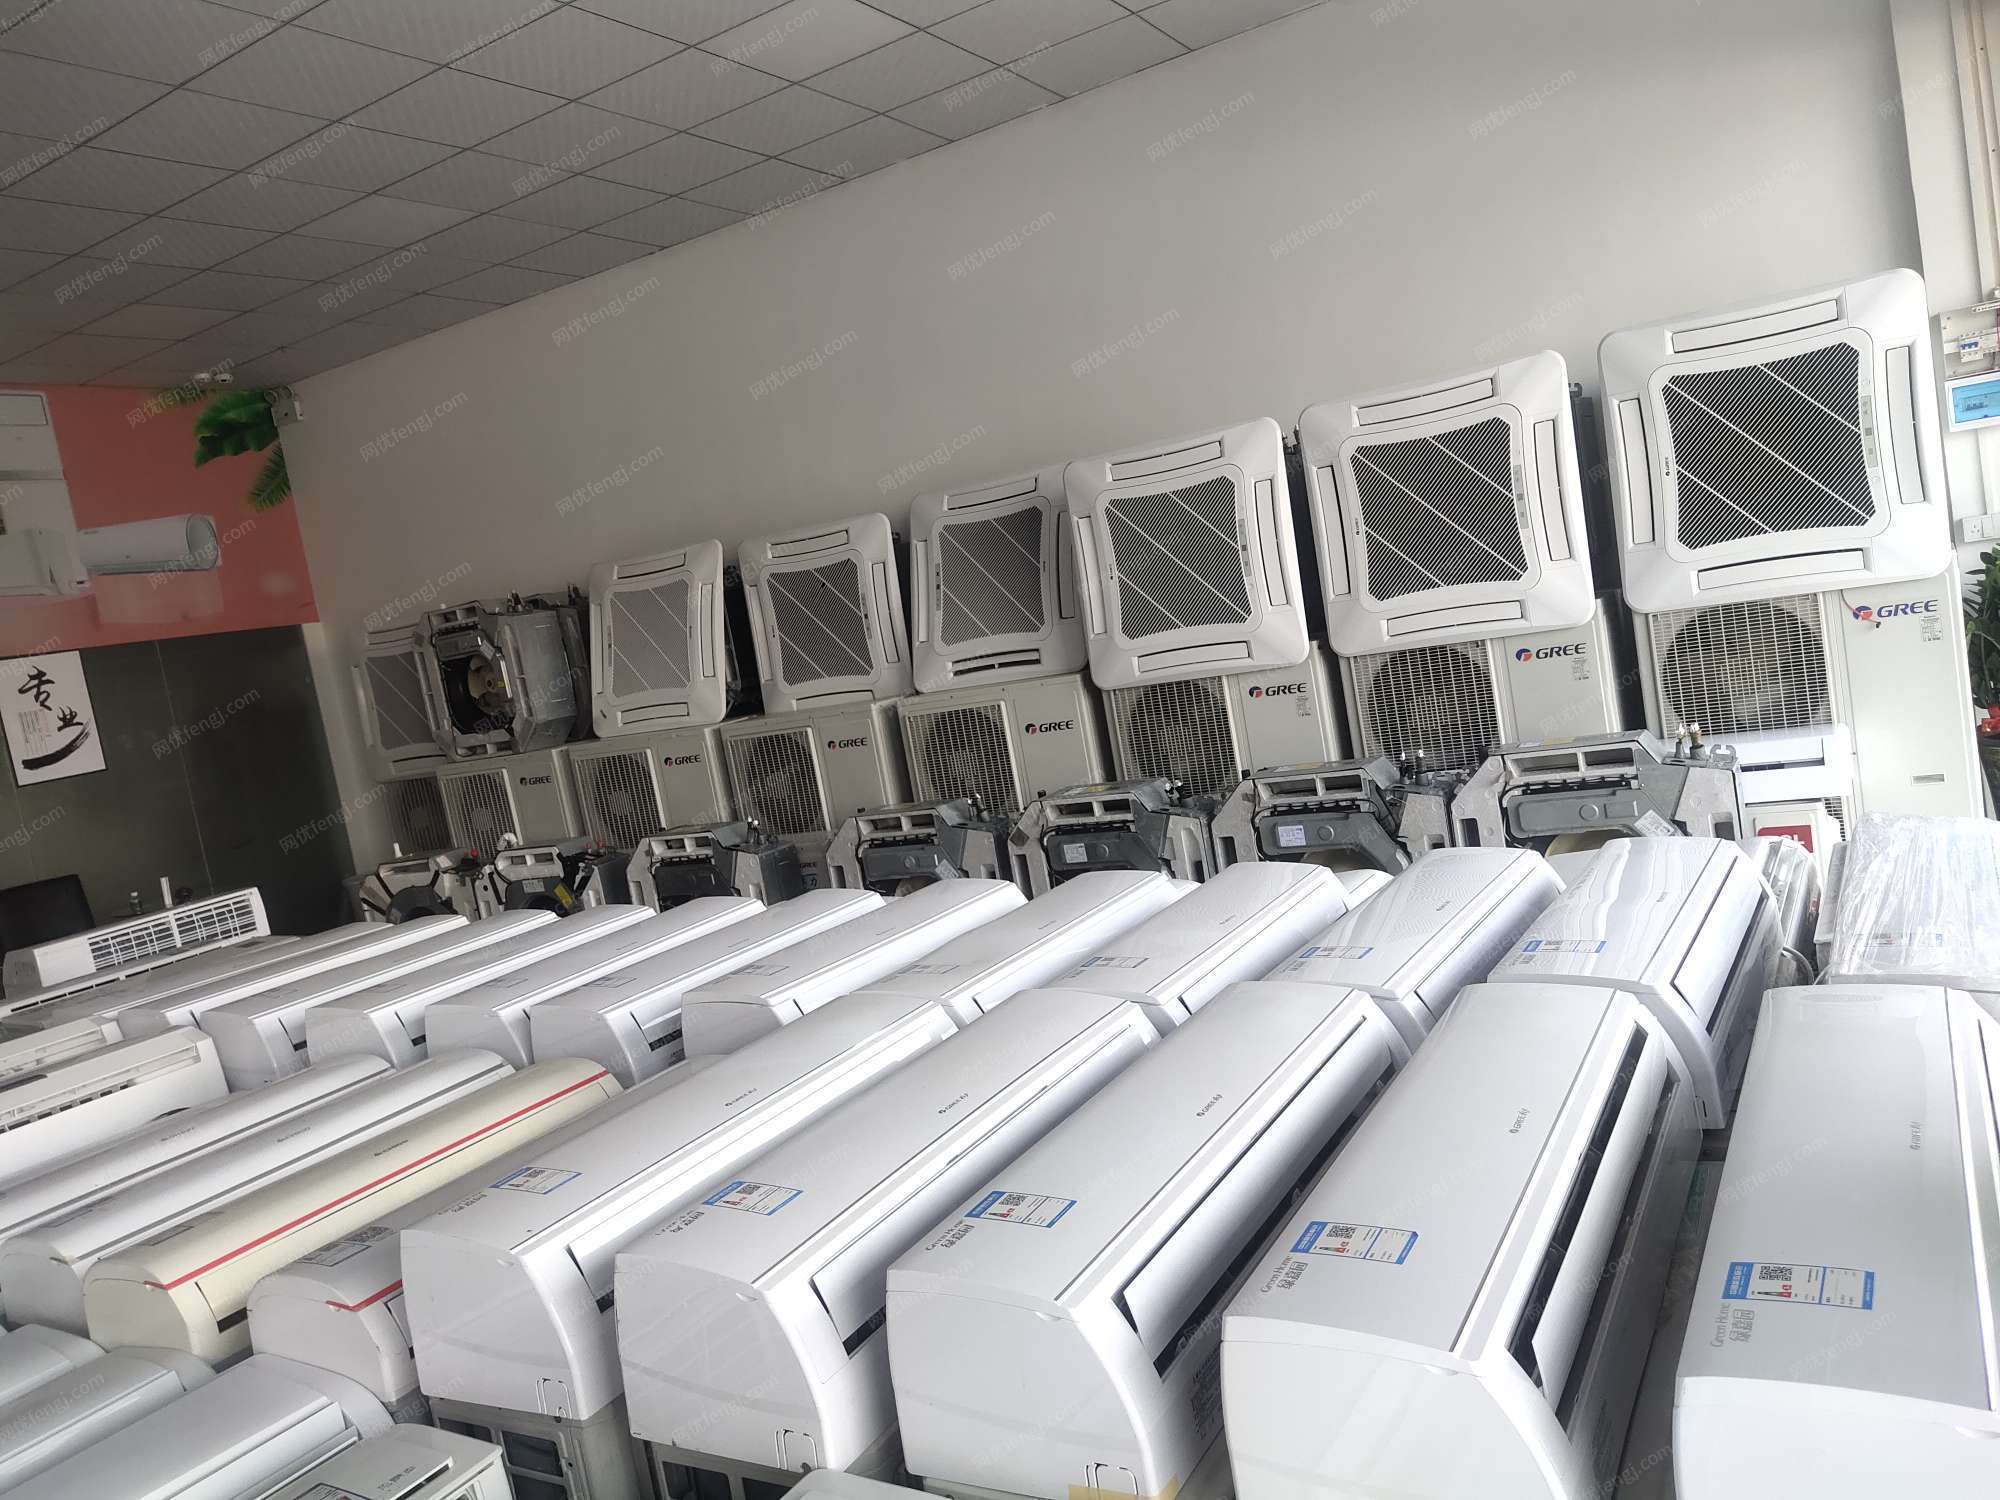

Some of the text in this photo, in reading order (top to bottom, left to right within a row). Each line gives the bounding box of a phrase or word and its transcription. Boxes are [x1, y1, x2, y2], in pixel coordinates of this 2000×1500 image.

[1877, 600, 1938, 618] GREE
[1535, 642, 1587, 660] GREE
[1265, 682, 1307, 697] GREE
[1039, 719, 1074, 733] GREE
[838, 737, 868, 749] GREE
[674, 754, 701, 766] GREE
[528, 775, 552, 786] GREE
